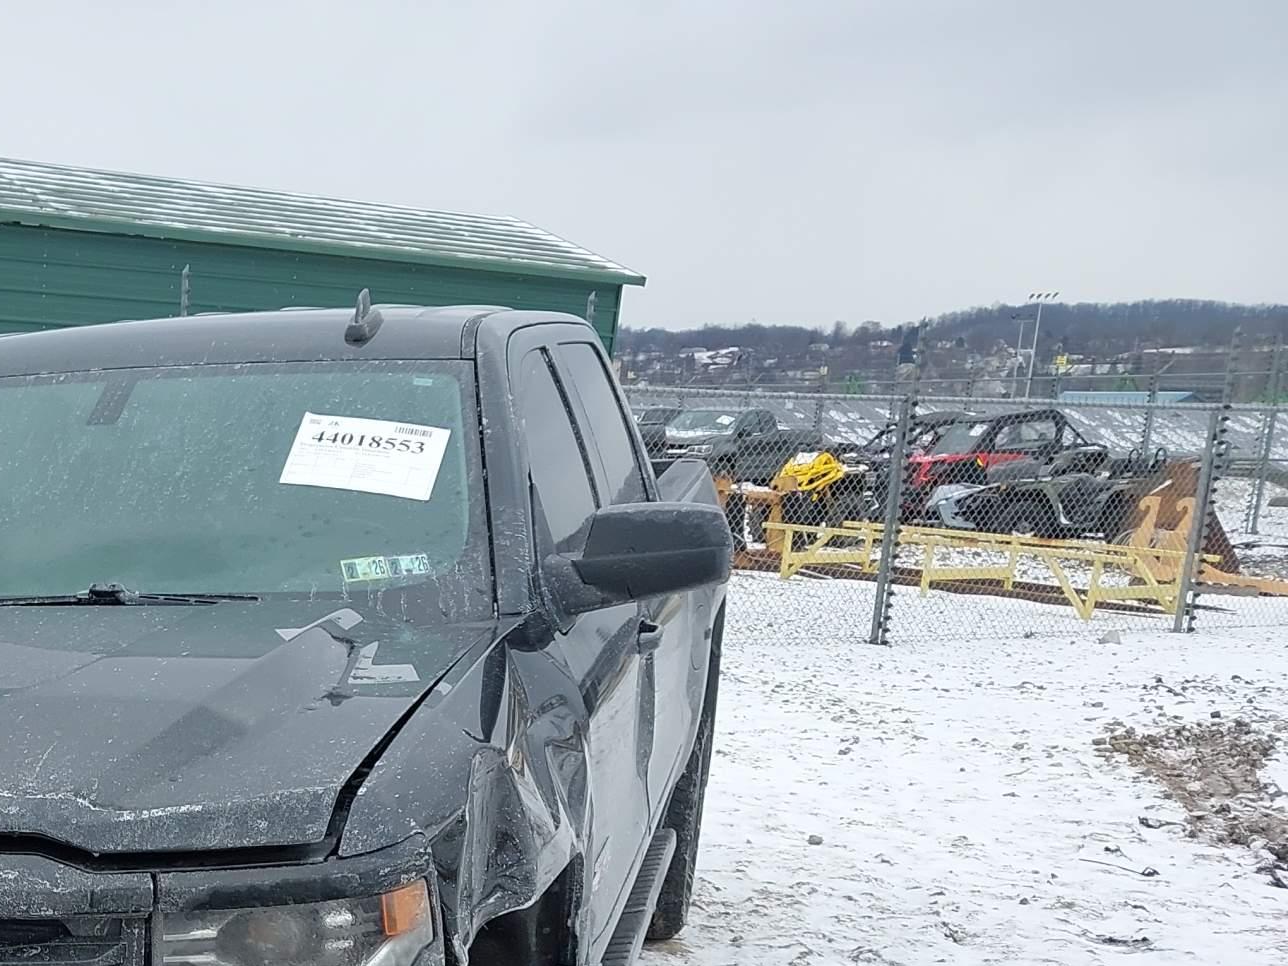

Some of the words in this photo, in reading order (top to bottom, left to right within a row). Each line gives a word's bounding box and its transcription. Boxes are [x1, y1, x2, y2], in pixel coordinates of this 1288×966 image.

[311, 430, 426, 455] 44018553
[372, 559, 386, 576] 26
[415, 556, 429, 572] 26
